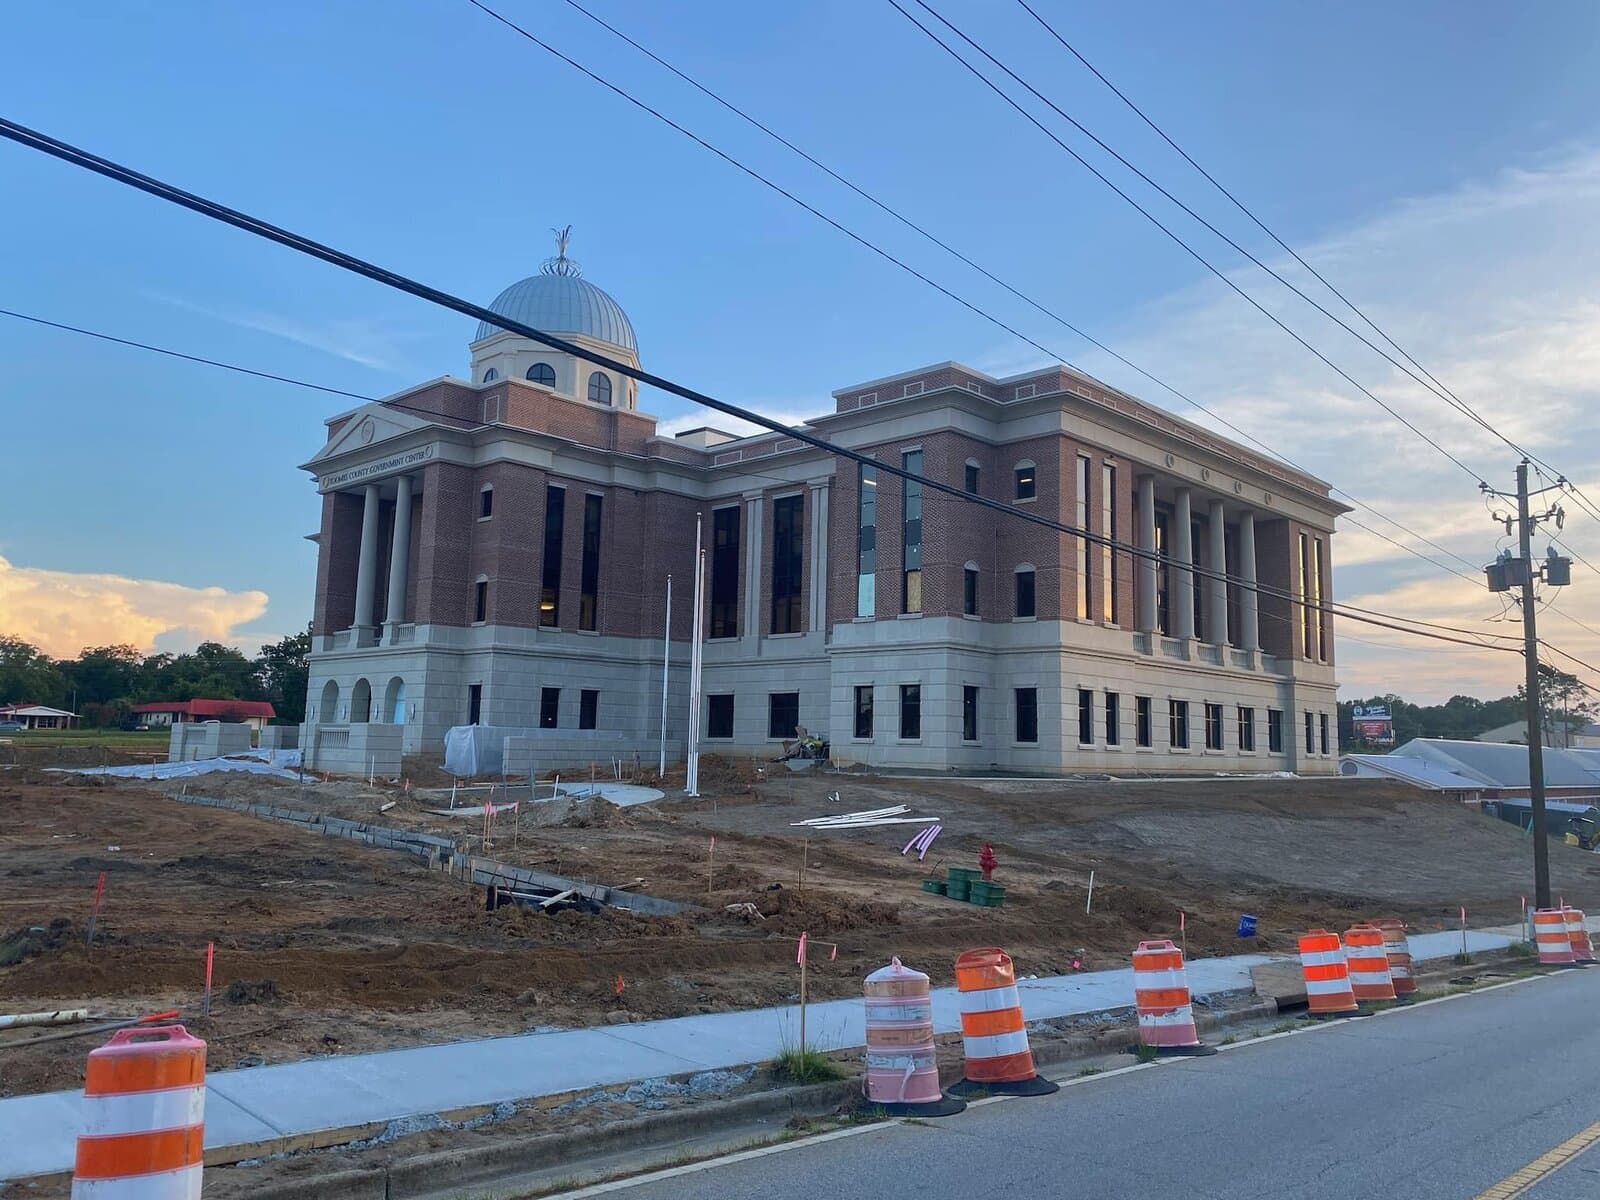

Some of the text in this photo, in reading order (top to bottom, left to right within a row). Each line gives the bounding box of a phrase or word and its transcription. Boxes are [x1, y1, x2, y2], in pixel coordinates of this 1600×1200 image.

[349, 467, 369, 480] COUNTY
[370, 457, 404, 473] GOVERNMENT
[405, 451, 425, 463] CENTER
